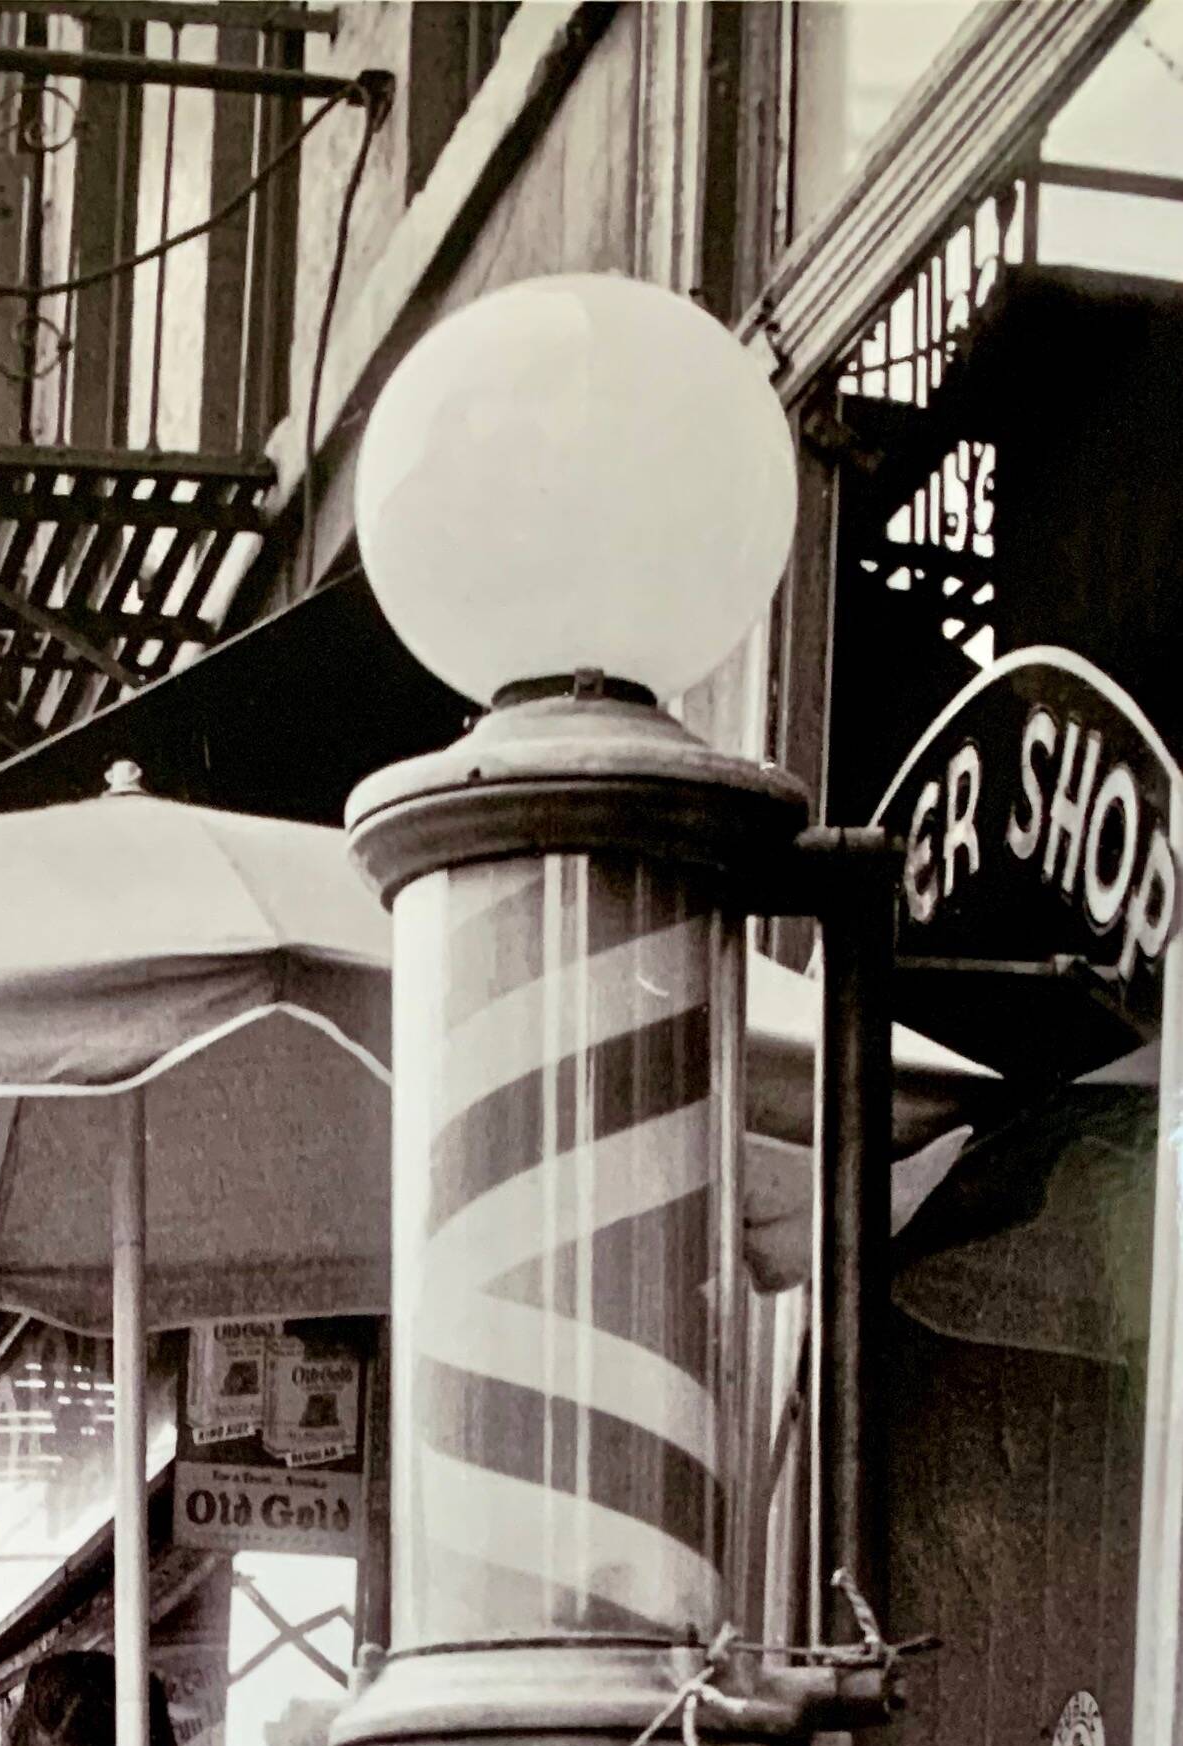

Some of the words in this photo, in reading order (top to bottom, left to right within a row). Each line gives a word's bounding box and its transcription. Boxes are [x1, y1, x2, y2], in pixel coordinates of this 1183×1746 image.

[1006, 704, 1175, 978] SHOP
[186, 1489, 252, 1527] Old
[261, 1493, 350, 1532] Gold
